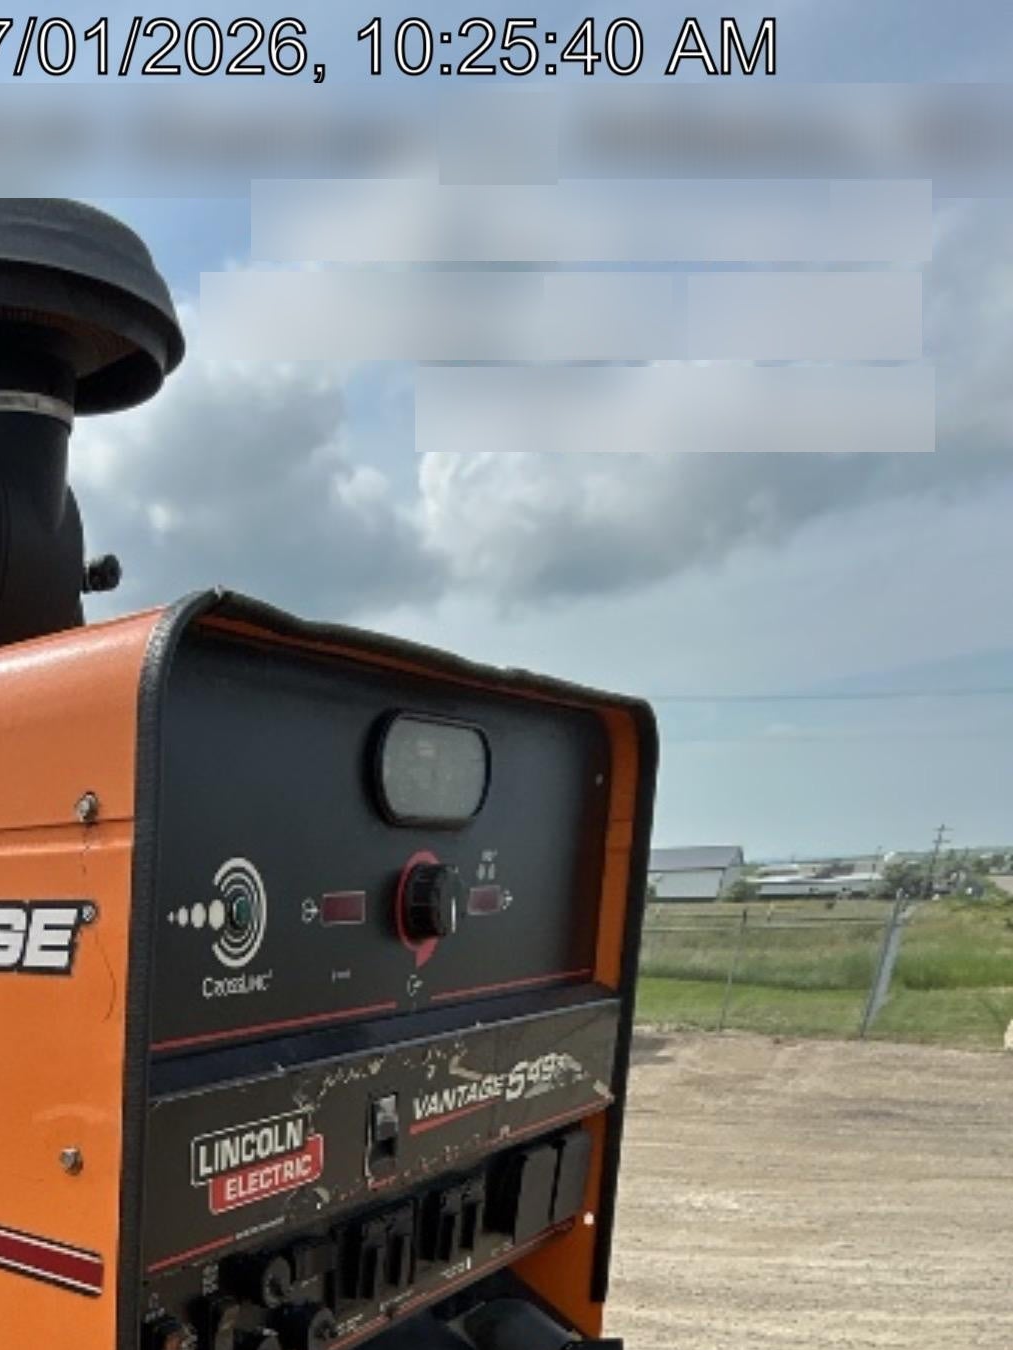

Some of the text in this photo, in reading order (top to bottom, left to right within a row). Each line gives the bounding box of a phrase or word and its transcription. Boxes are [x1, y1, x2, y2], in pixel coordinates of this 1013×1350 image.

[413, 1072, 506, 1120] VANTAGE
[199, 1118, 304, 1177] LINCOLN
[225, 1154, 313, 1202] ELECTRIC
